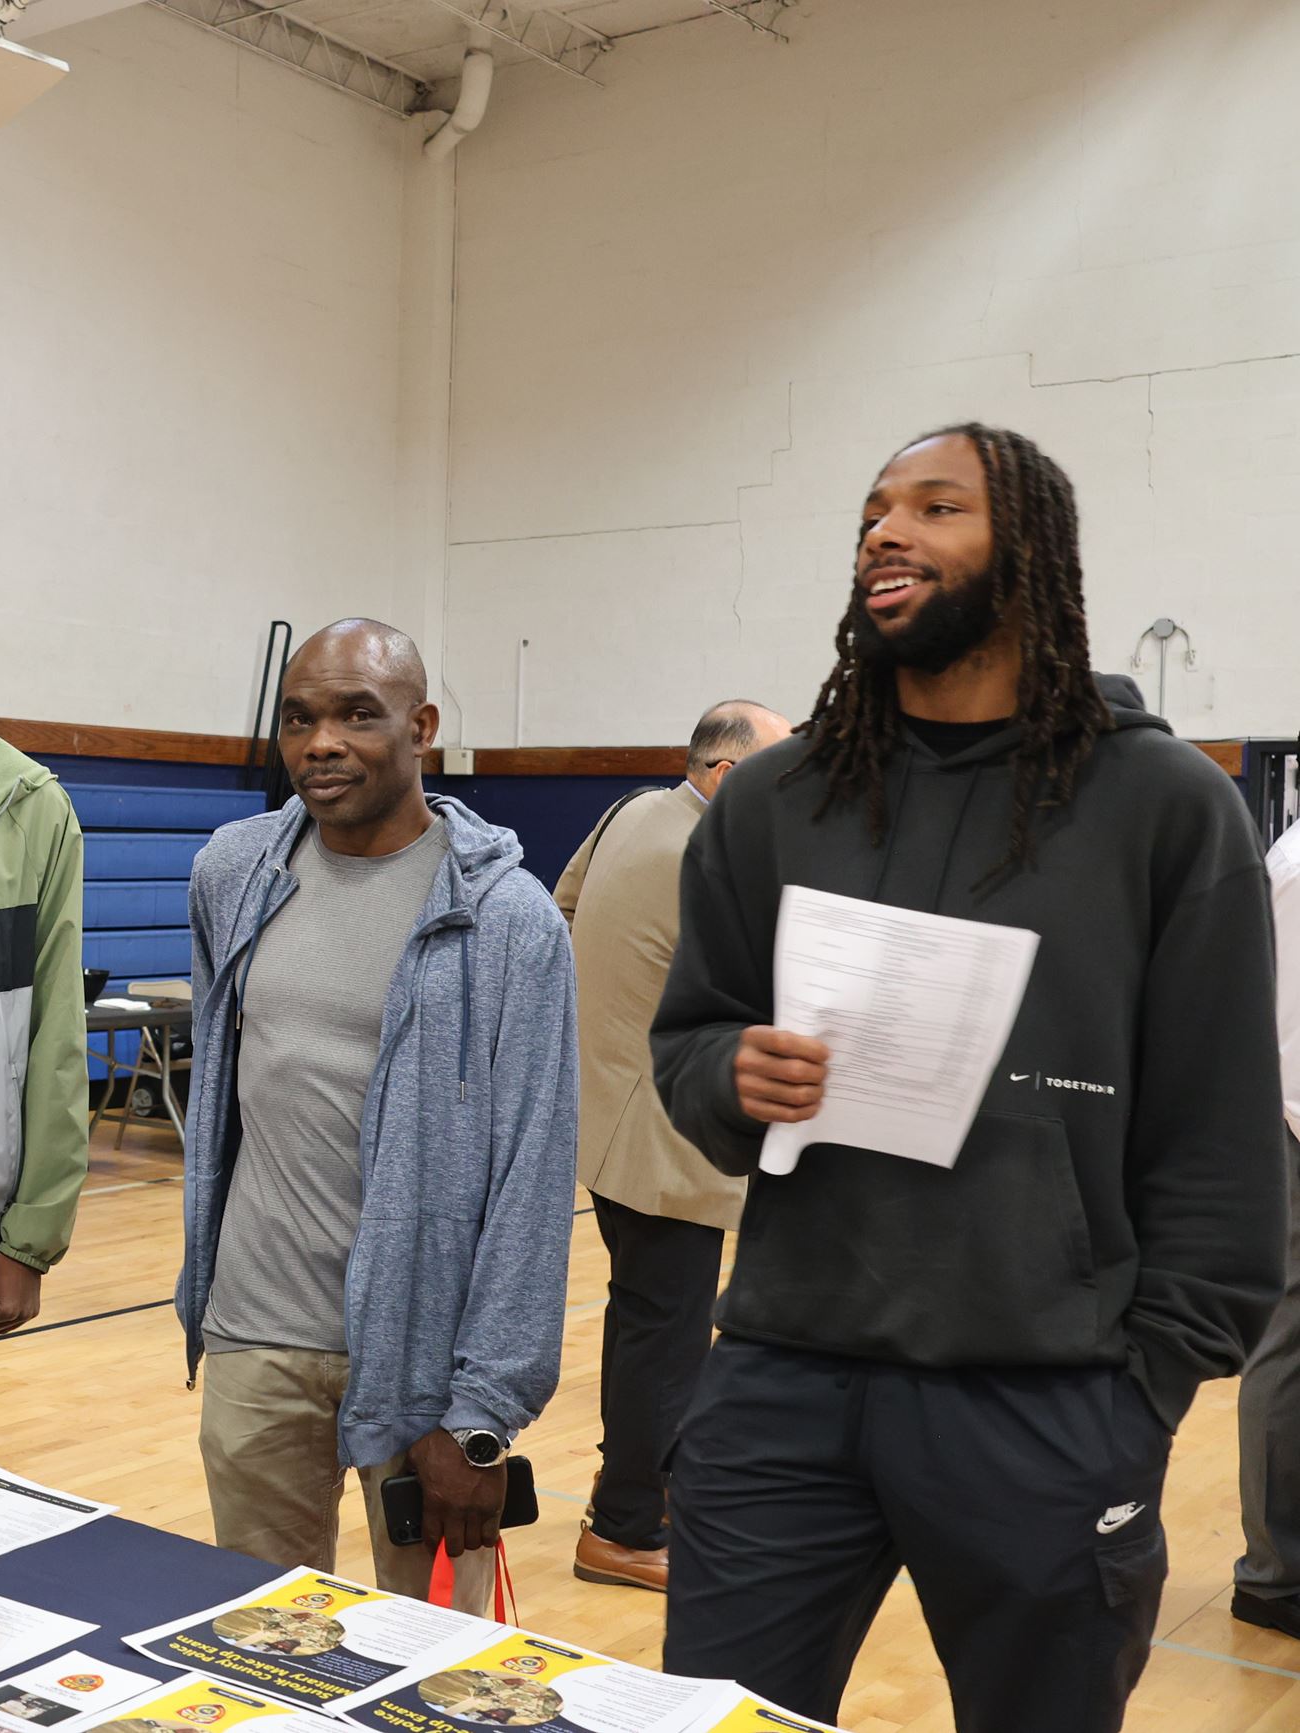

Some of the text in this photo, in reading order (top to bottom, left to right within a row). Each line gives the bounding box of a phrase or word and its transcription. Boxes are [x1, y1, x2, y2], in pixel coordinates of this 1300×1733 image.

[168, 1642, 215, 1662] Police
[176, 1634, 219, 1654] Exam
[214, 1658, 272, 1681] County
[219, 1650, 289, 1677] Make-Up
[273, 1677, 333, 1699] Suffolk
[289, 1673, 355, 1696] Military
[373, 1709, 425, 1732] Police
[380, 1700, 428, 1723] Exam
